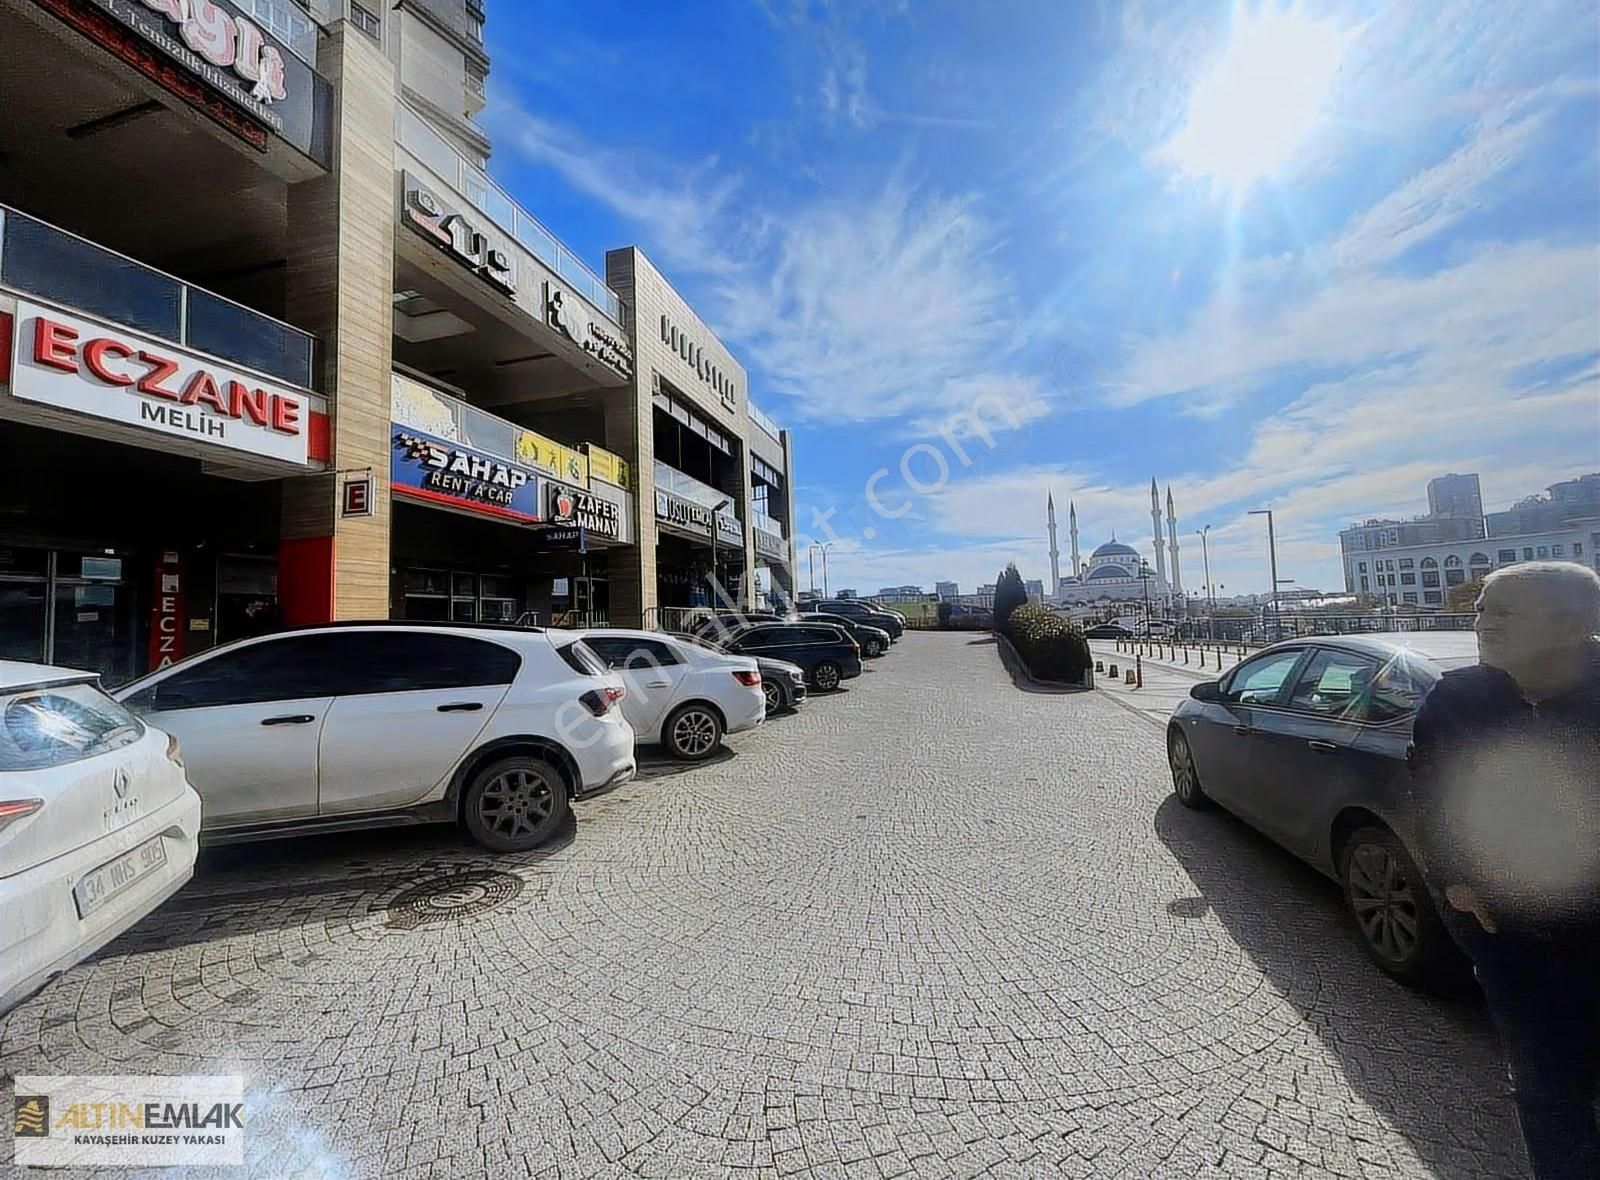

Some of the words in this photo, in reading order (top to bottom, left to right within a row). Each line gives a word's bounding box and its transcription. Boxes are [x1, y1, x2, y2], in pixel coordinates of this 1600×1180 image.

[33, 317, 300, 436] ECZANE
[141, 401, 225, 438] MELİH
[348, 484, 366, 510] E
[431, 471, 469, 494] RENT
[475, 484, 484, 497] A
[488, 487, 512, 505] CAR
[577, 493, 619, 520] ZAFER
[577, 511, 619, 536] MANAV
[86, 874, 105, 903] 34
